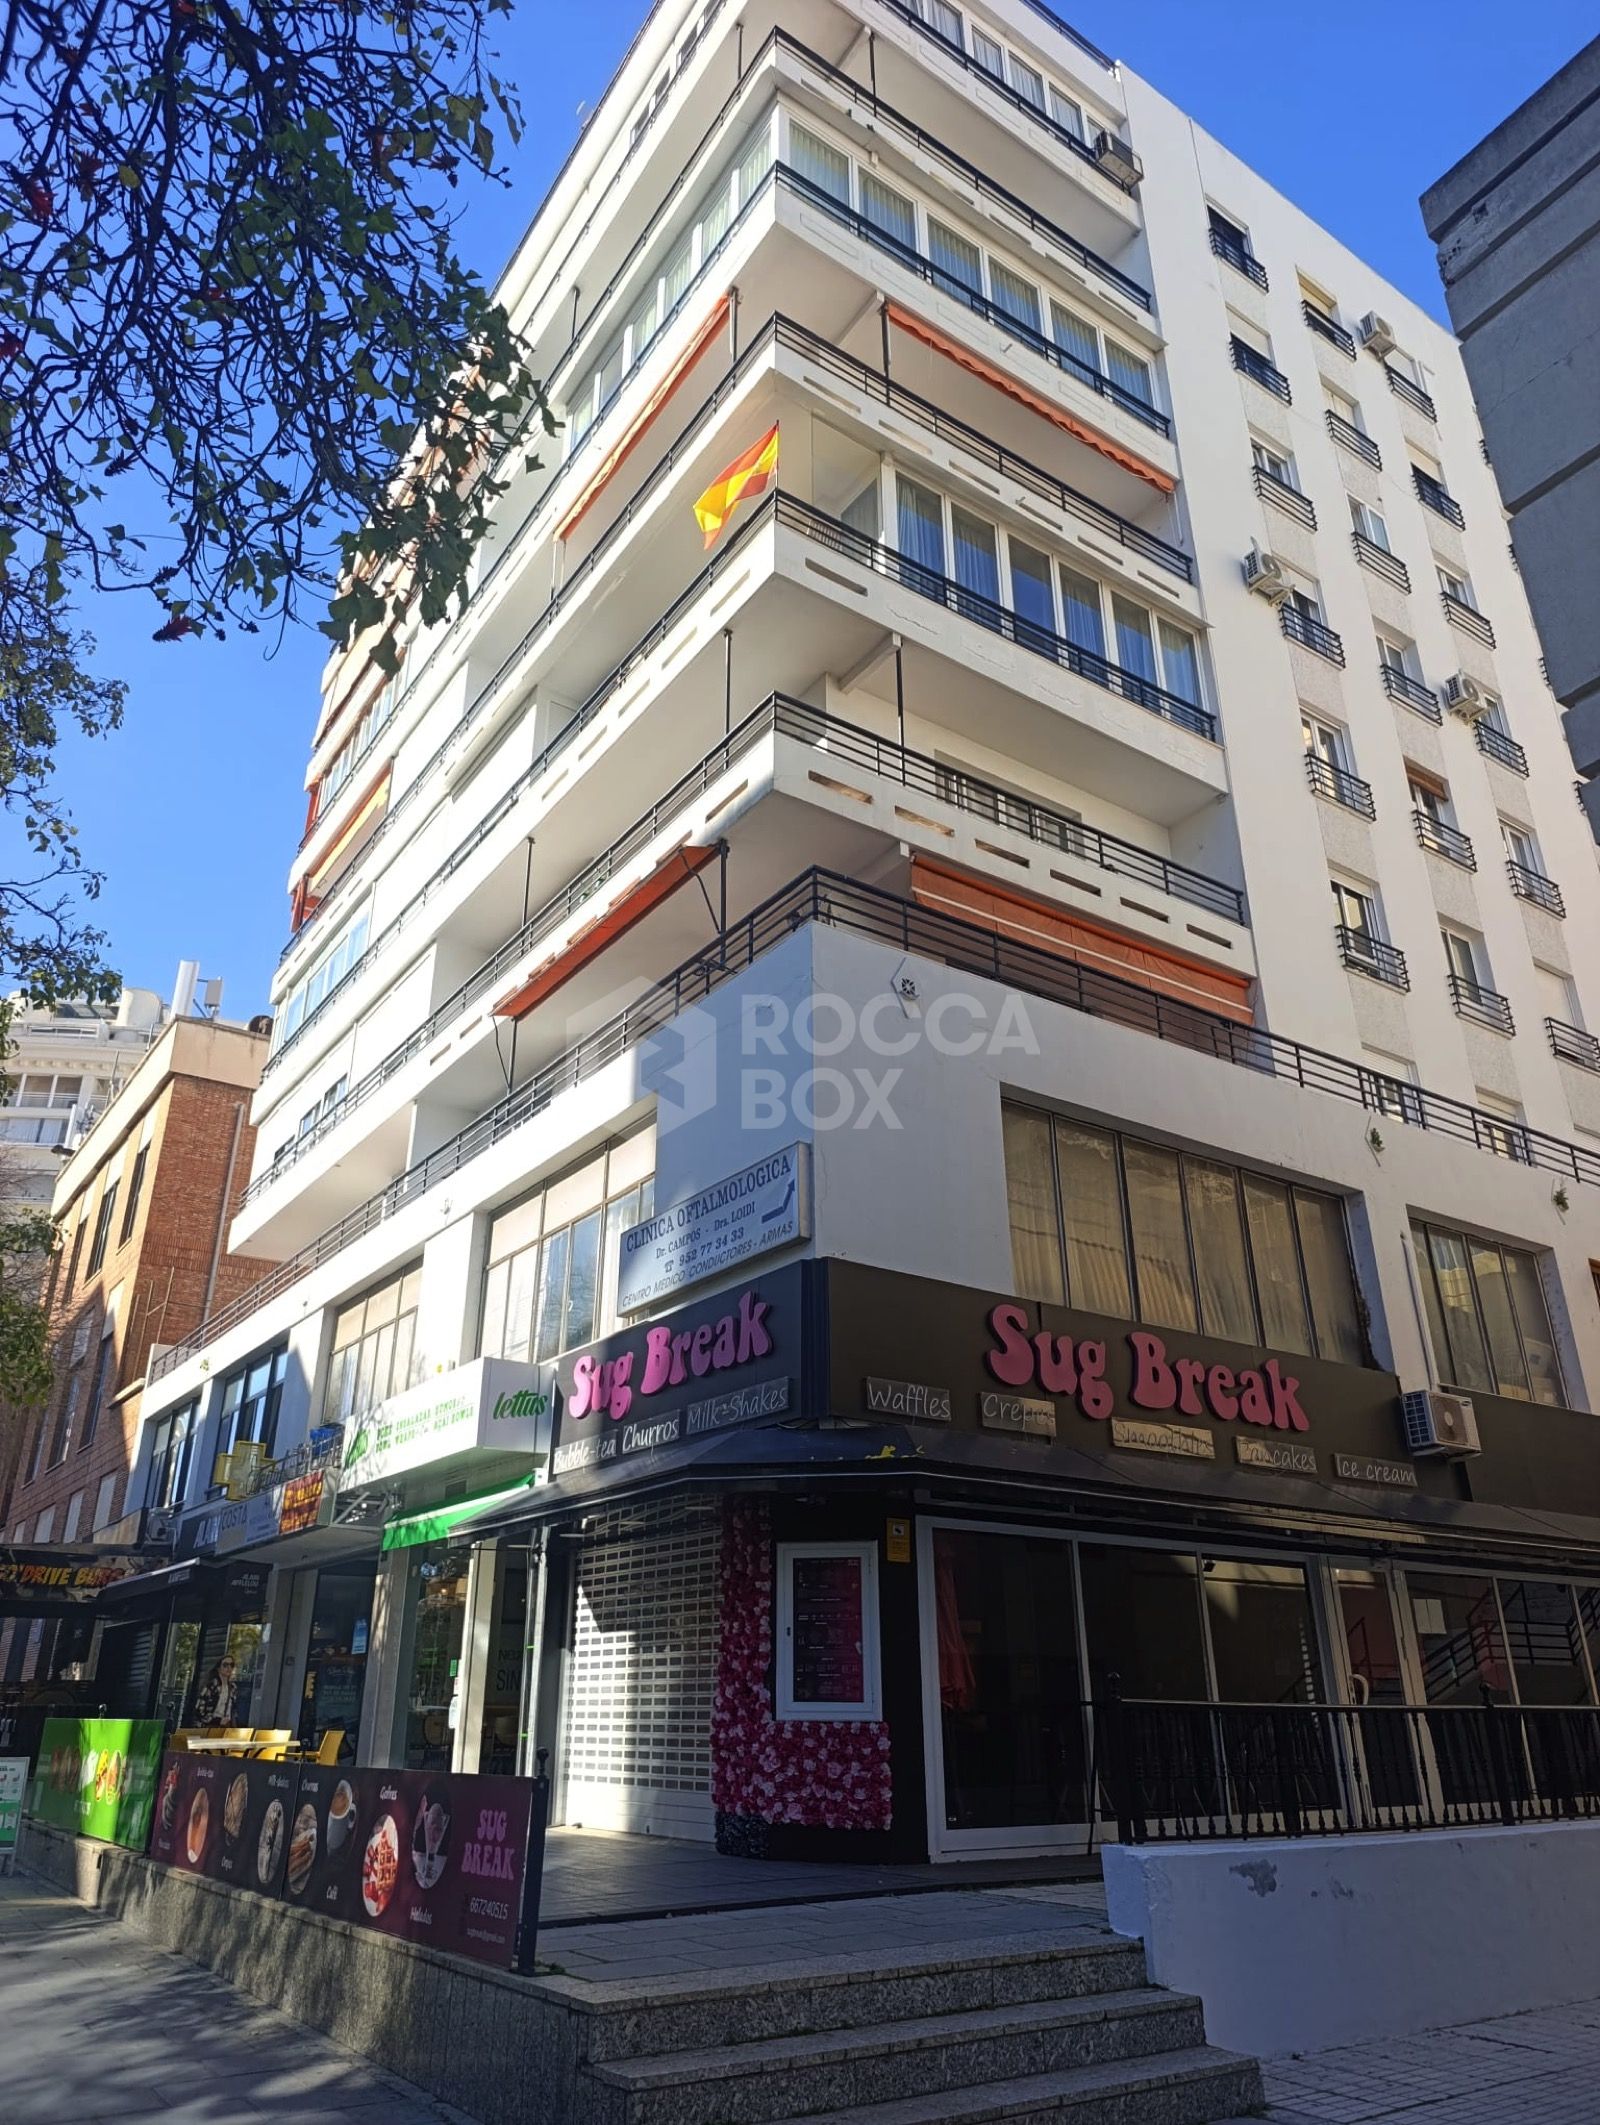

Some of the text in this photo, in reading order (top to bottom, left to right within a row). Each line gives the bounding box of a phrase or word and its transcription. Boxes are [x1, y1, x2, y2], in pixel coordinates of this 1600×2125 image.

[626, 1154, 792, 1253] CLINICA OFTALMOLOGICA
[668, 1227, 701, 1253] CAMPOS
[731, 1201, 756, 1223] LOIDI
[678, 1226, 745, 1267] 952 77 34 33
[622, 1285, 652, 1307] CENTRO
[653, 1270, 686, 1293] MEDICO
[688, 1239, 753, 1278] CONDUCTORES
[759, 1220, 794, 1247] ARMAS
[569, 1290, 772, 1420] Sug Break
[986, 1303, 1310, 1431] Sug Break
[868, 1382, 951, 1418] Waffles
[622, 1416, 681, 1452] Churros
[1338, 1454, 1417, 1485] Ice cream
[477, 1809, 507, 1842] SUG
[461, 1842, 516, 1881] BREAK
